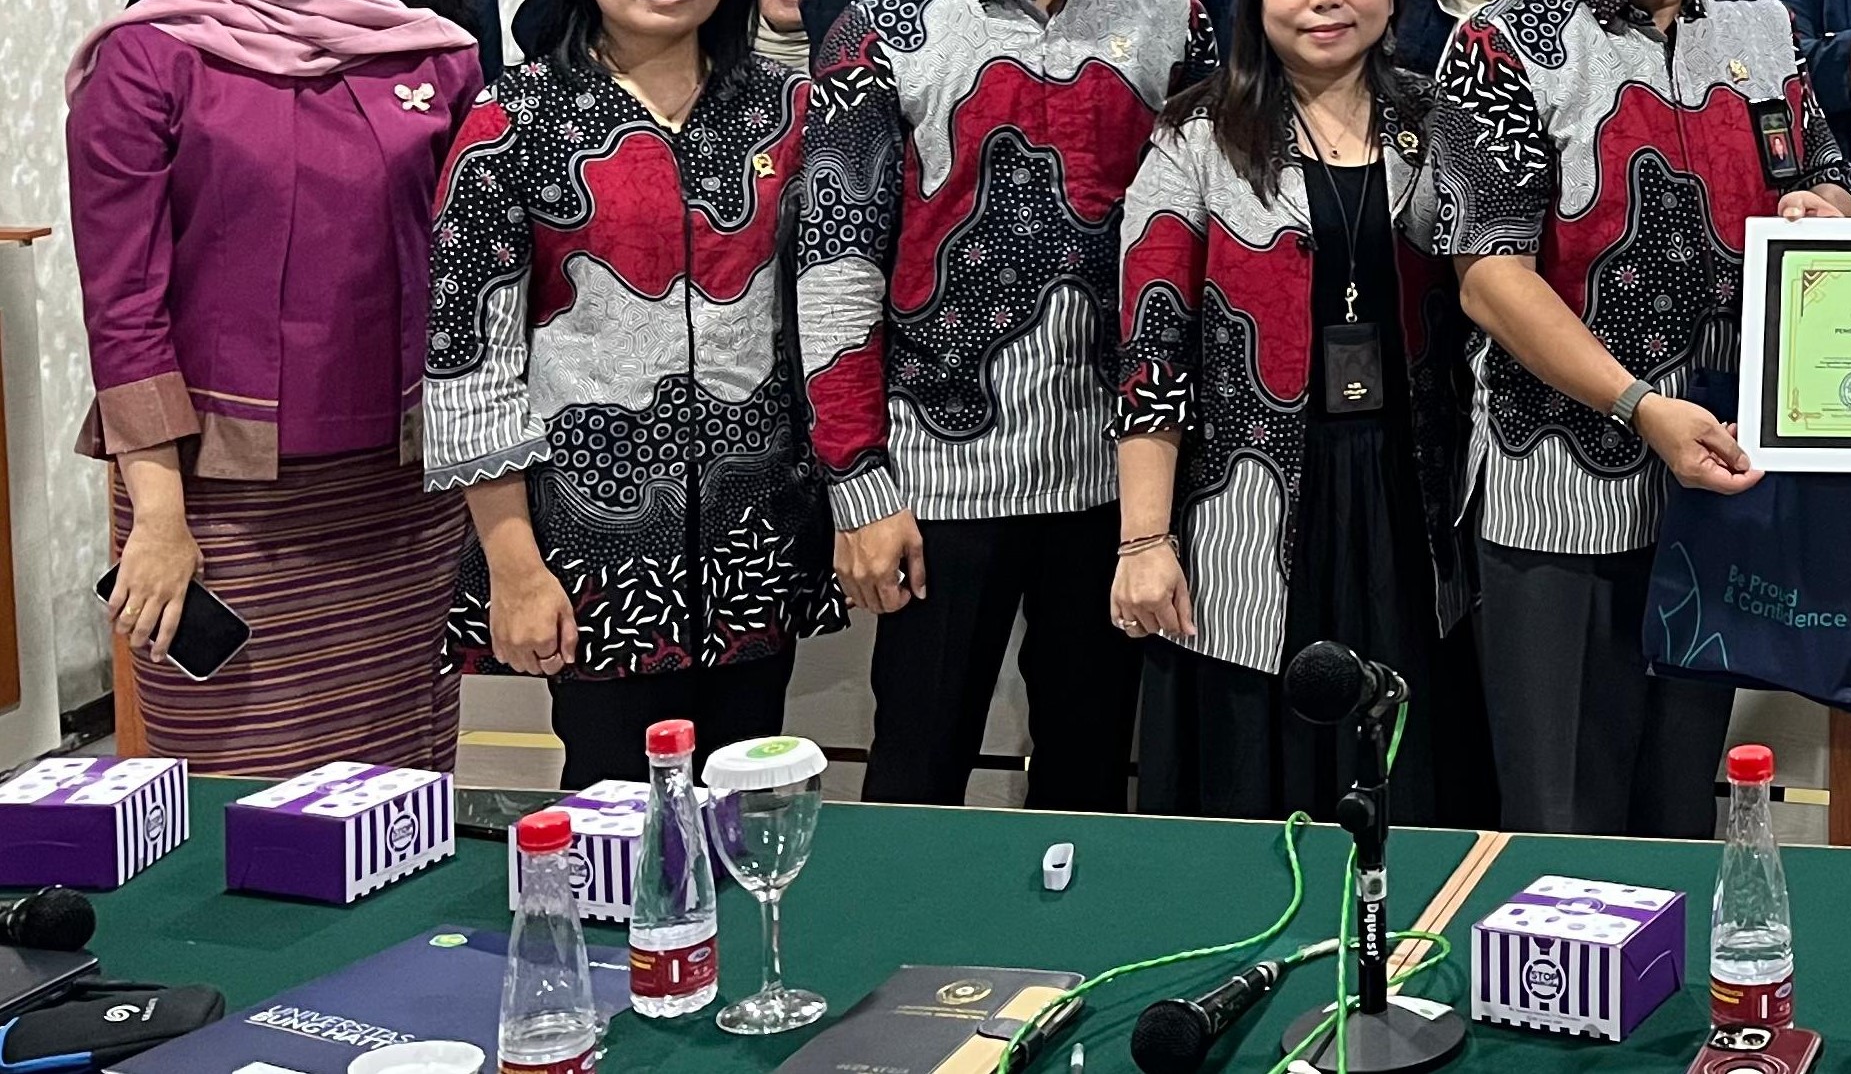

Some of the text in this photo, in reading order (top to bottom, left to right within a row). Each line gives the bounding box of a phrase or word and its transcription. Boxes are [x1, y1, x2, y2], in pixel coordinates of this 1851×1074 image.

[1728, 564, 1798, 607] Be Proud
[1723, 585, 1848, 628] & Confidence
[249, 1011, 395, 1050] BUNG HATT
[267, 1004, 416, 1043] UNIVERSITAS
